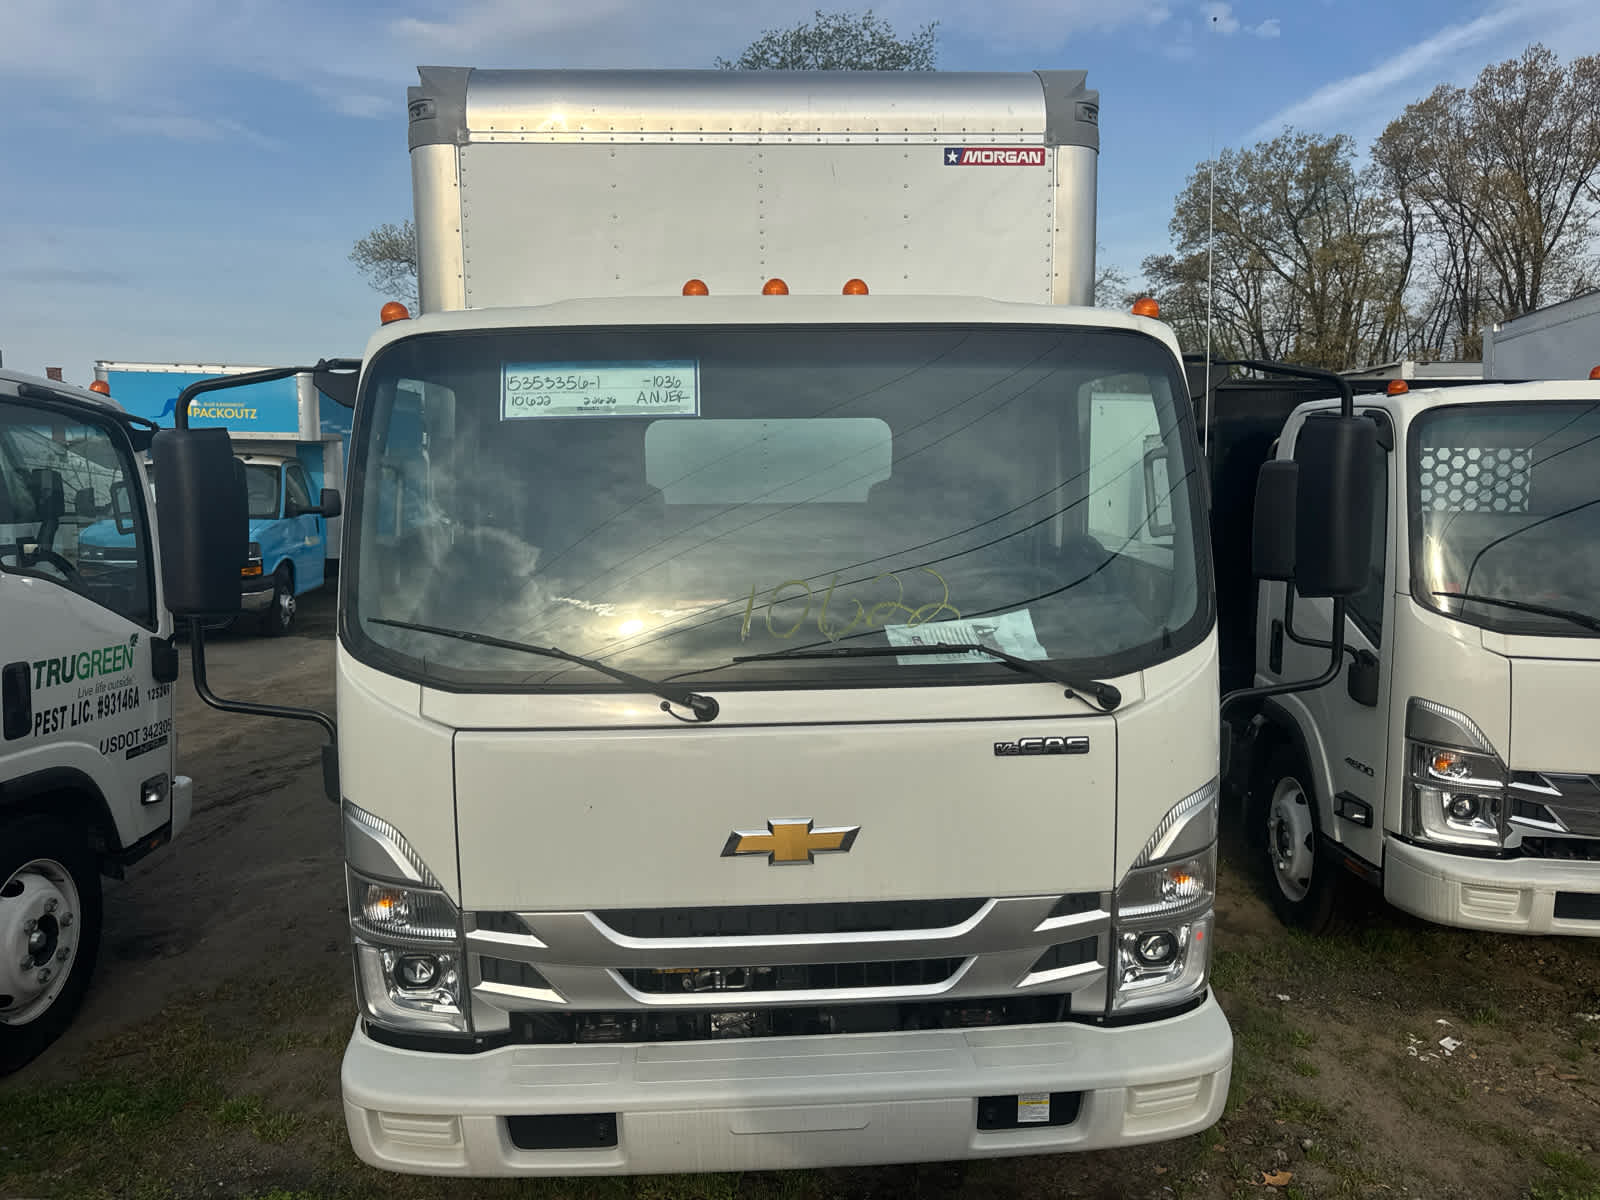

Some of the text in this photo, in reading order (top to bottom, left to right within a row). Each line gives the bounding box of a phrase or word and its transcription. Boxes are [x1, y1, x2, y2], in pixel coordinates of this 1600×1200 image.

[962, 150, 1041, 164] MORGAN
[192, 407, 258, 419] PACKOUTZ
[33, 644, 134, 690] TRUGREEN
[77, 687, 94, 699] Live
[95, 681, 107, 694] life
[34, 686, 140, 737] PEST LIC. #93146A
[99, 728, 141, 756] USDOT
